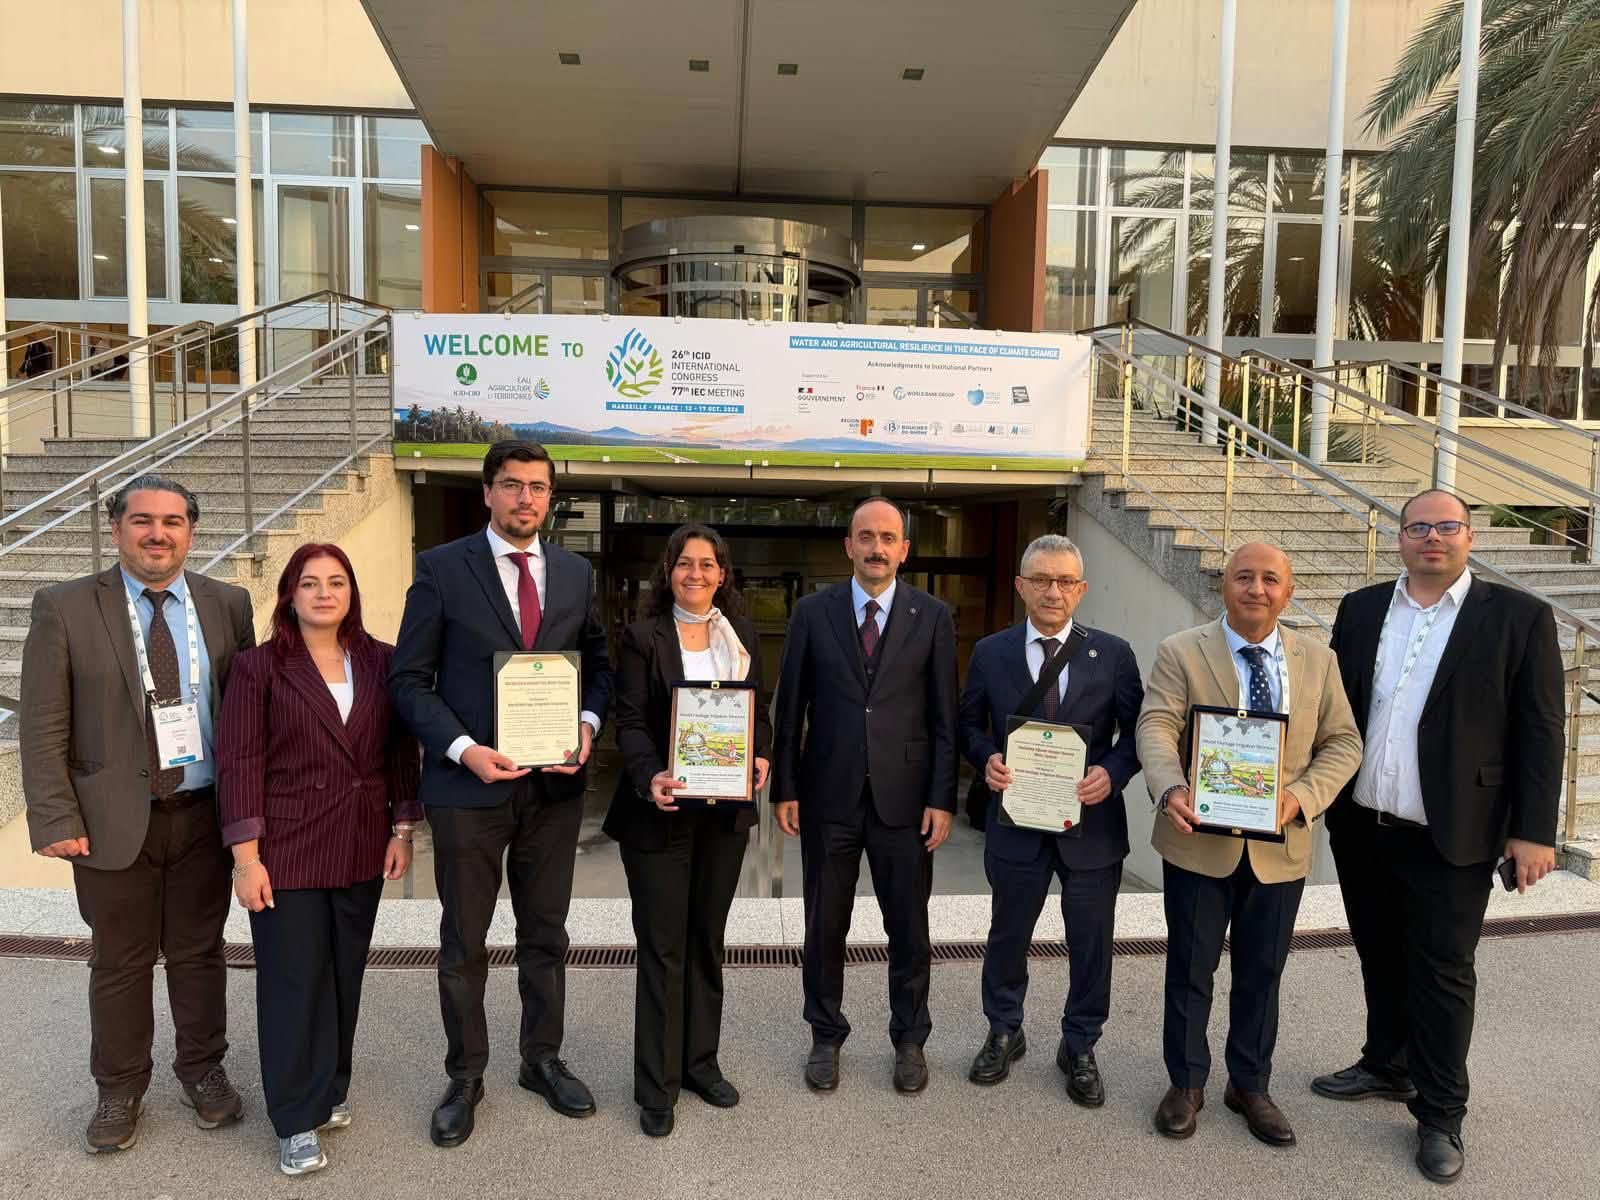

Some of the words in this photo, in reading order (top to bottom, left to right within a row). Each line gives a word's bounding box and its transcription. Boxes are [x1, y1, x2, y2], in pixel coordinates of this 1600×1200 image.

[424, 334, 549, 357] WELCOME
[561, 342, 584, 358] TO
[791, 338, 819, 347] WATER
[821, 339, 838, 348] AND
[840, 340, 897, 350] AGRICULTURAL
[899, 342, 943, 352] RESILIENCE
[944, 344, 952, 352] IN
[954, 345, 968, 353] THE
[970, 346, 987, 354] FACE
[988, 347, 998, 355] OF
[999, 347, 1029, 357] CLIMATE
[1030, 349, 1058, 358] CHANGE
[671, 350, 689, 359] 26th
[692, 351, 711, 360] ICID
[671, 361, 740, 372] INTERNATIONAL
[867, 361, 923, 370] Acknowledgments
[931, 363, 966, 371] Institutional
[671, 372, 718, 382] CONGRESS
[488, 384, 531, 392] AGRICULTURE
[671, 386, 689, 396] 77th
[691, 387, 705, 397] IEC
[707, 388, 745, 398] MEETING
[798, 394, 846, 402] GOUVERNEMENT
[611, 402, 646, 410] MARSEILLE
[654, 403, 678, 411] FRANCE
